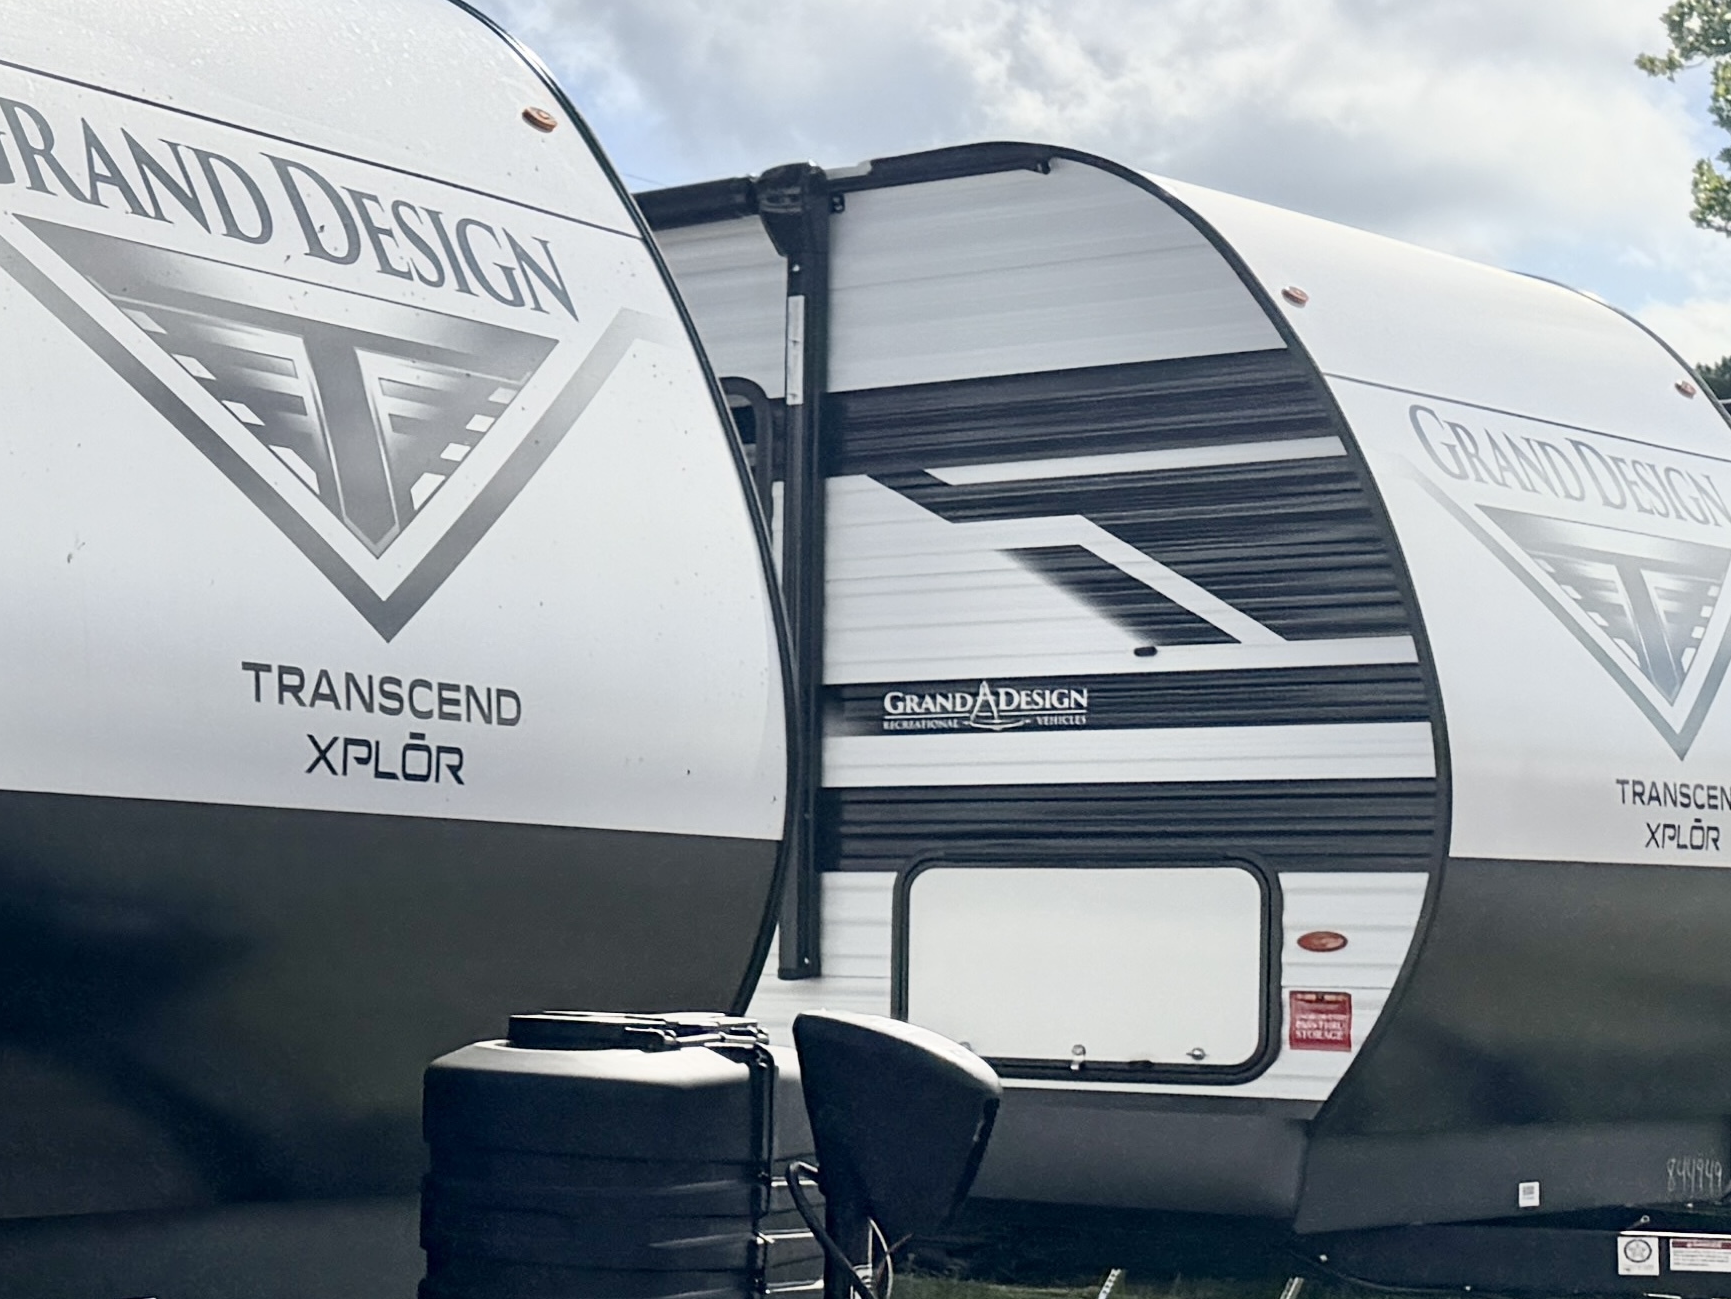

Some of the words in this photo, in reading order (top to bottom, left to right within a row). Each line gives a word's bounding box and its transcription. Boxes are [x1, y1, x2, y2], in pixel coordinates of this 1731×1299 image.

[259, 152, 579, 322] DESIGN
[1408, 404, 1586, 503] GRAND
[1564, 437, 1731, 528] DESIGN
[241, 660, 522, 727] TRANSCEND
[882, 718, 959, 730] RECREATIONAL
[1035, 715, 1087, 726] VEHICLES
[883, 691, 974, 714] GRAND
[997, 687, 1088, 710] DESIGN
